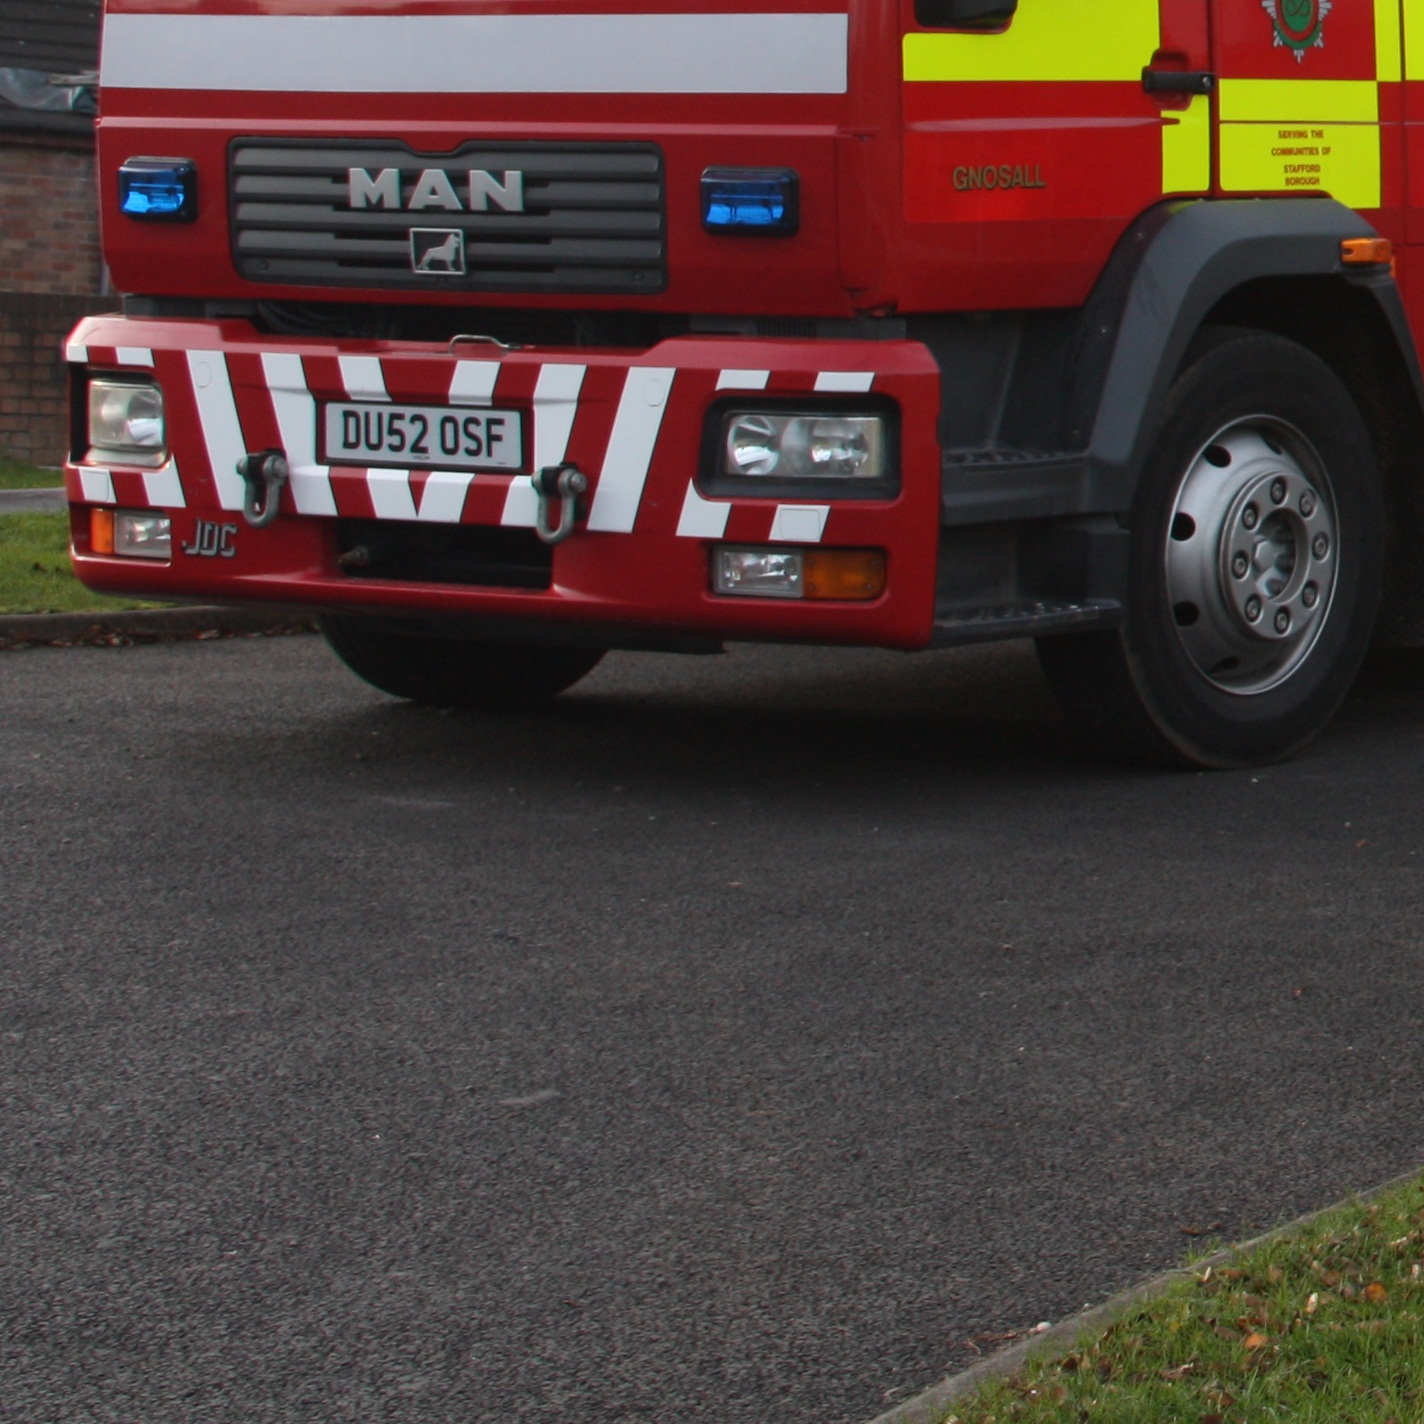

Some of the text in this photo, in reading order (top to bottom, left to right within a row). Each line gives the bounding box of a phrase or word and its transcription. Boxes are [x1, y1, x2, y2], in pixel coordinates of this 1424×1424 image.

[1278, 130, 1324, 139] SERVING THE
[1271, 146, 1331, 156] COMMUNITIES OF
[1284, 164, 1320, 173] STAFFORD
[953, 164, 1047, 191] GNOSALL
[1285, 177, 1320, 186] BOROUGH
[349, 168, 523, 211] MAN
[343, 410, 505, 457] DU52 OSF
